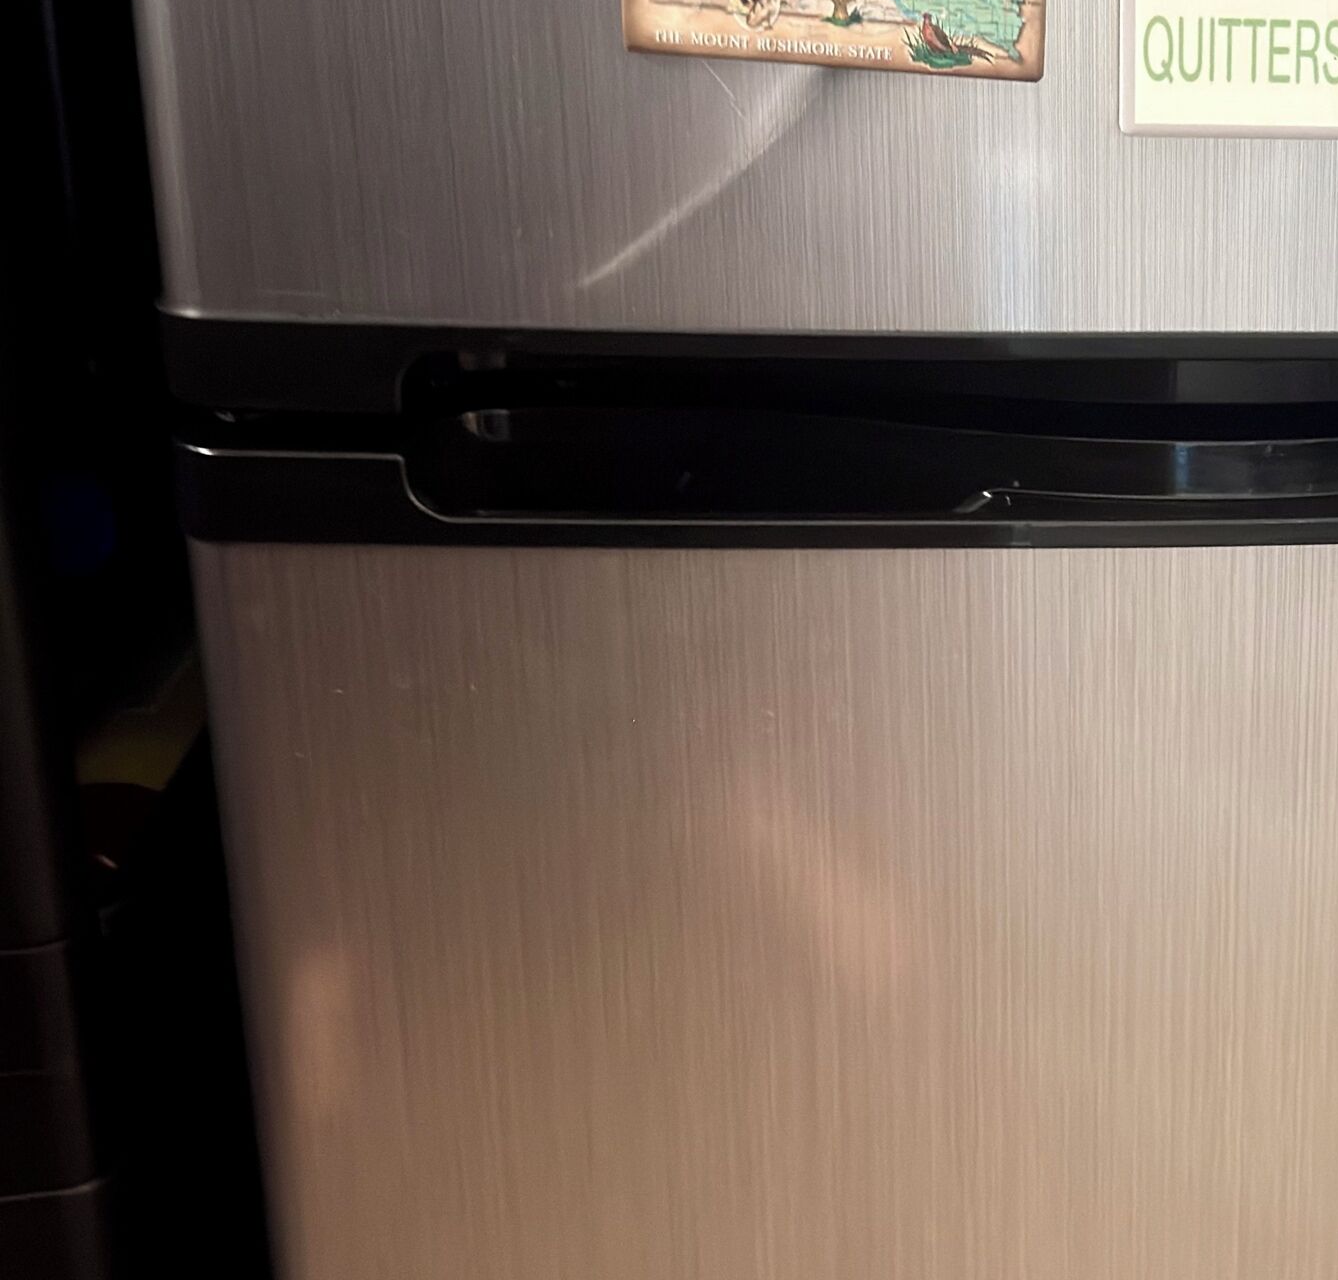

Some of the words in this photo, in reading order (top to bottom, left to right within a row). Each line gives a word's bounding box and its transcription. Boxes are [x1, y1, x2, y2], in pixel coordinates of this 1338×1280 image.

[655, 30, 683, 45] THE
[690, 31, 749, 50] MOUNT
[757, 38, 842, 57] RUSHMORE
[848, 45, 893, 61] STATE
